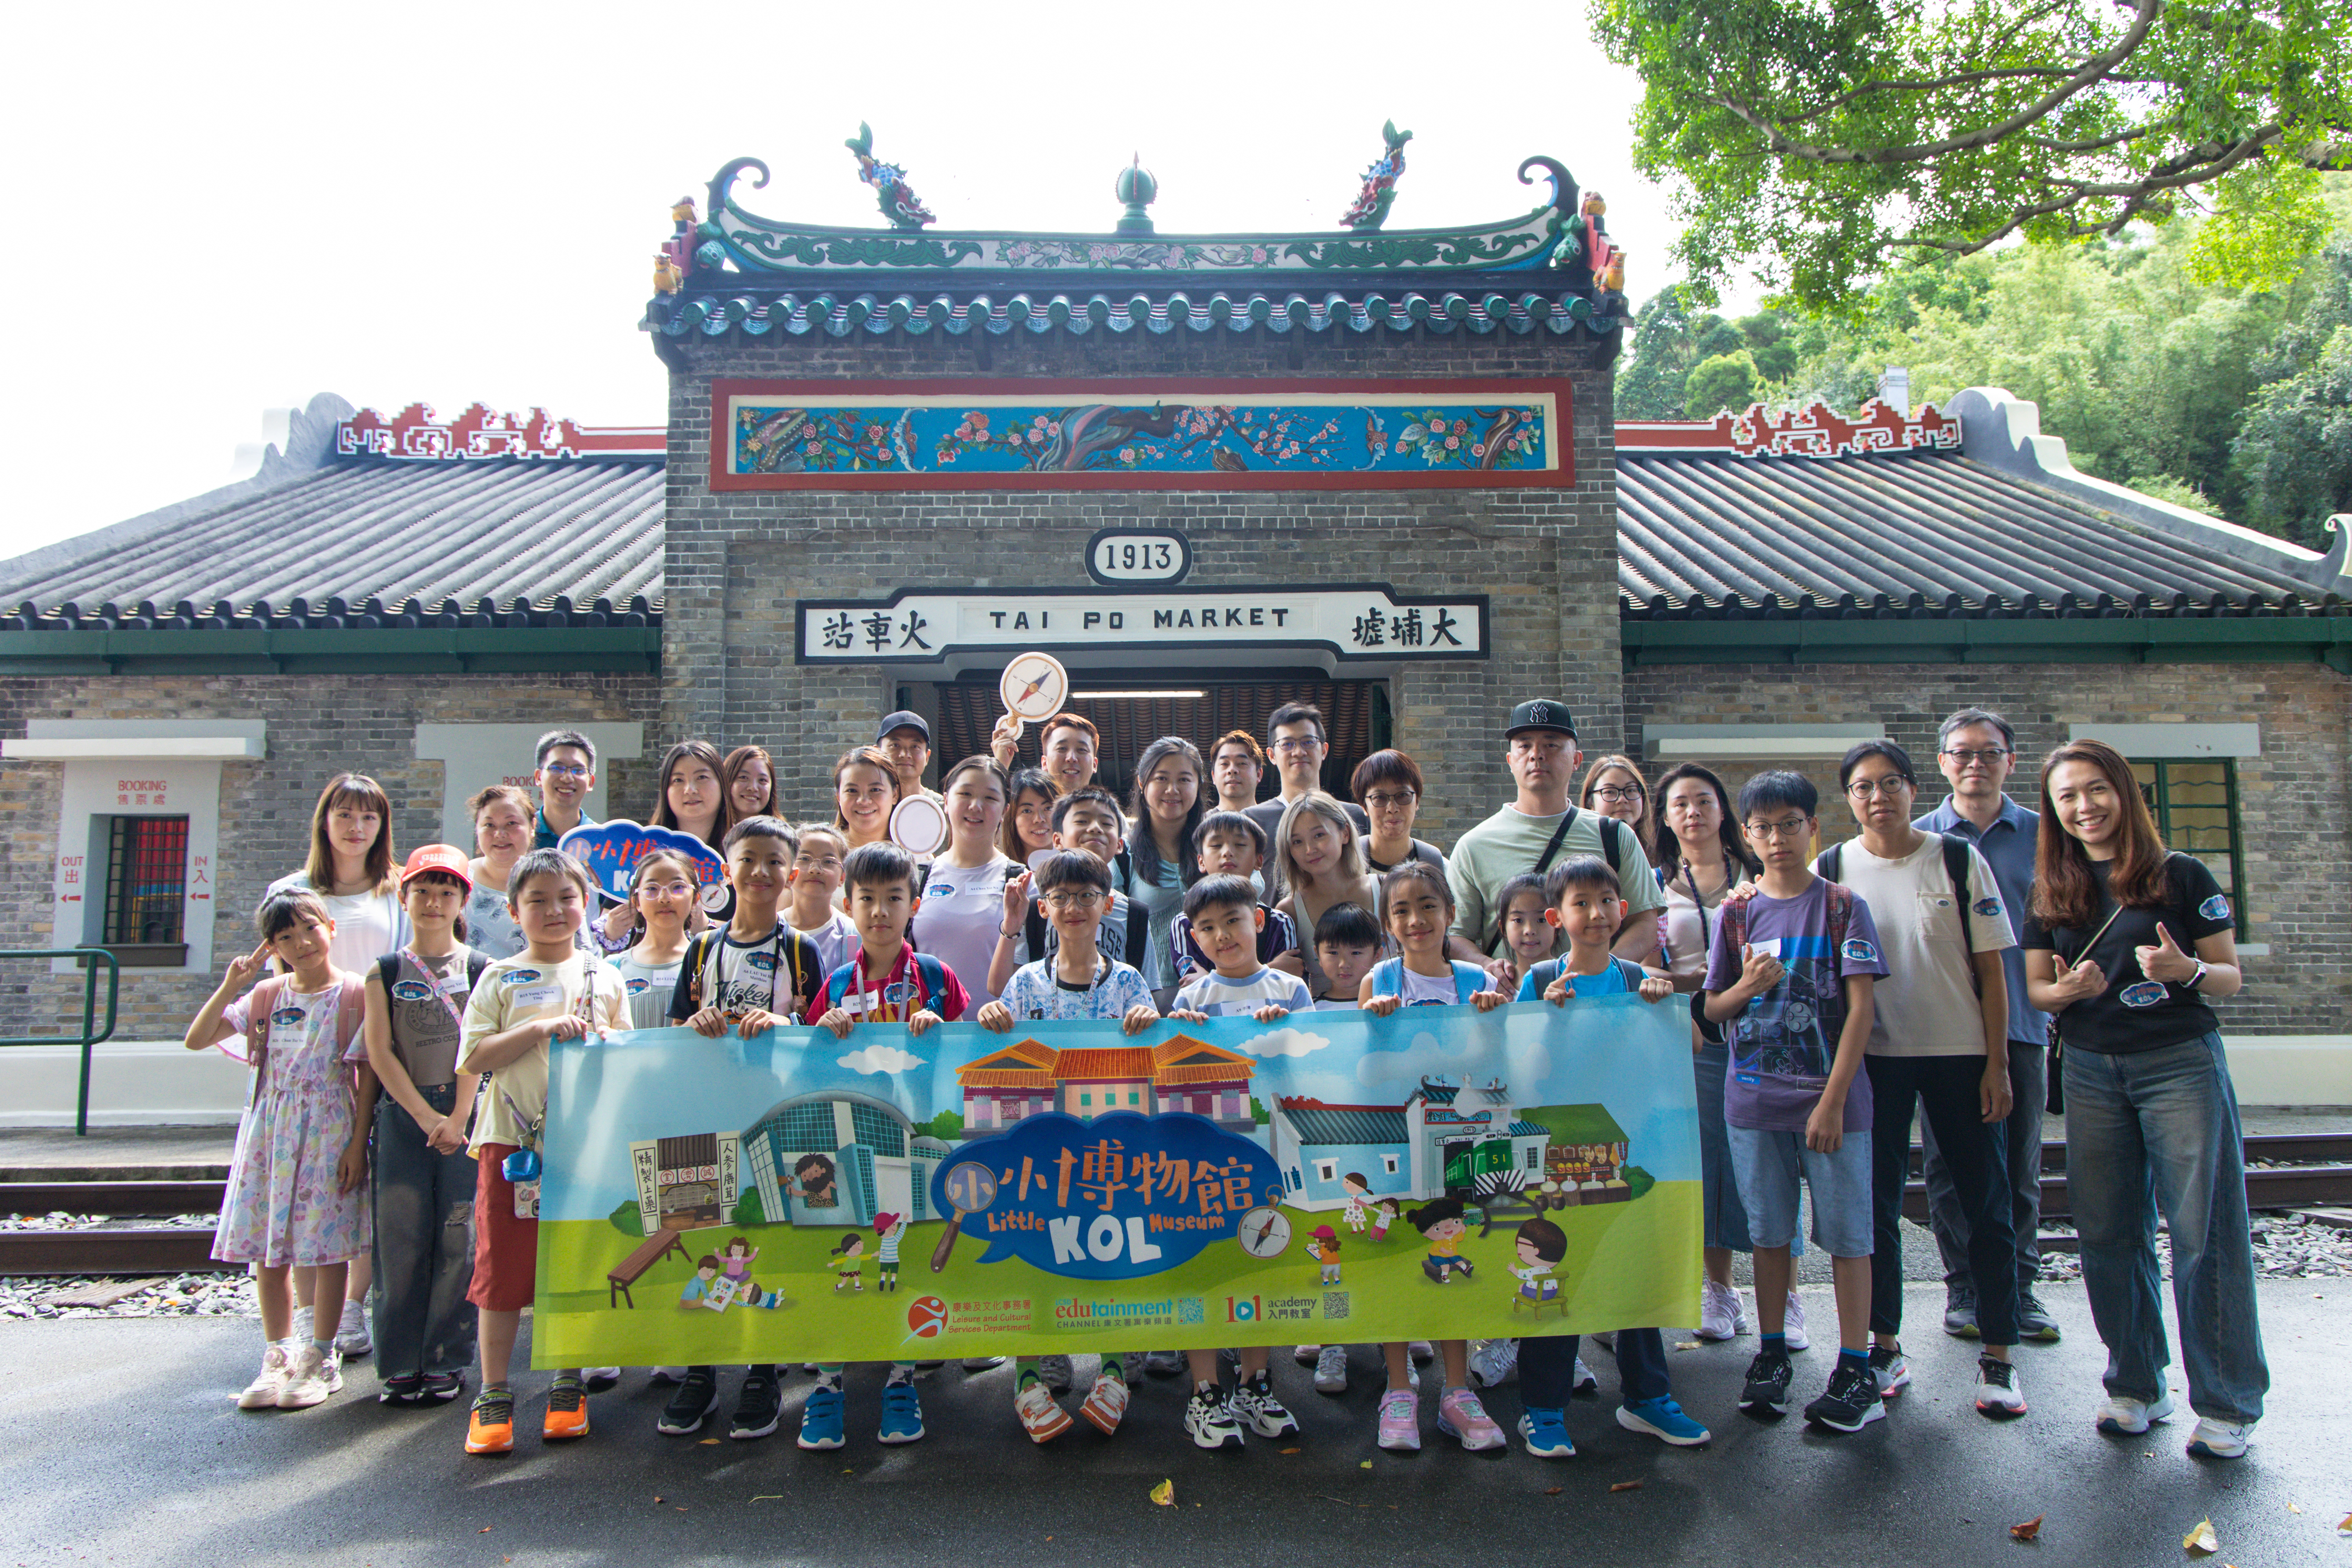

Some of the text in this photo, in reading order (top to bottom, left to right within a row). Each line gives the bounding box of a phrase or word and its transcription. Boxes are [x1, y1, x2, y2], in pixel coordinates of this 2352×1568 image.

[1106, 544, 1171, 570] 1913
[990, 608, 1289, 630] TAI PO MARKET
[118, 780, 167, 791] BOOKING
[503, 776, 536, 787] BOOKI
[62, 856, 83, 866] OUT
[194, 856, 207, 866] IN
[65, 869, 78, 884] 出
[193, 870, 208, 883] 入
[2138, 995, 2153, 1004] KOL
[1492, 1154, 1506, 1164] 51
[988, 1210, 1225, 1264] Little KOL Museum
[953, 1299, 1031, 1312] 康樂及文化事務署
[1055, 1298, 1173, 1318] edutainment
[1268, 1296, 1317, 1309] academy
[953, 1315, 980, 1324] Leisure
[1000, 1313, 1031, 1322] Cultural
[1268, 1308, 1311, 1320] 入門教室
[1057, 1317, 1172, 1328] CHANNEL 康文署寓樂頻道
[948, 1324, 1031, 1334] Services Department
